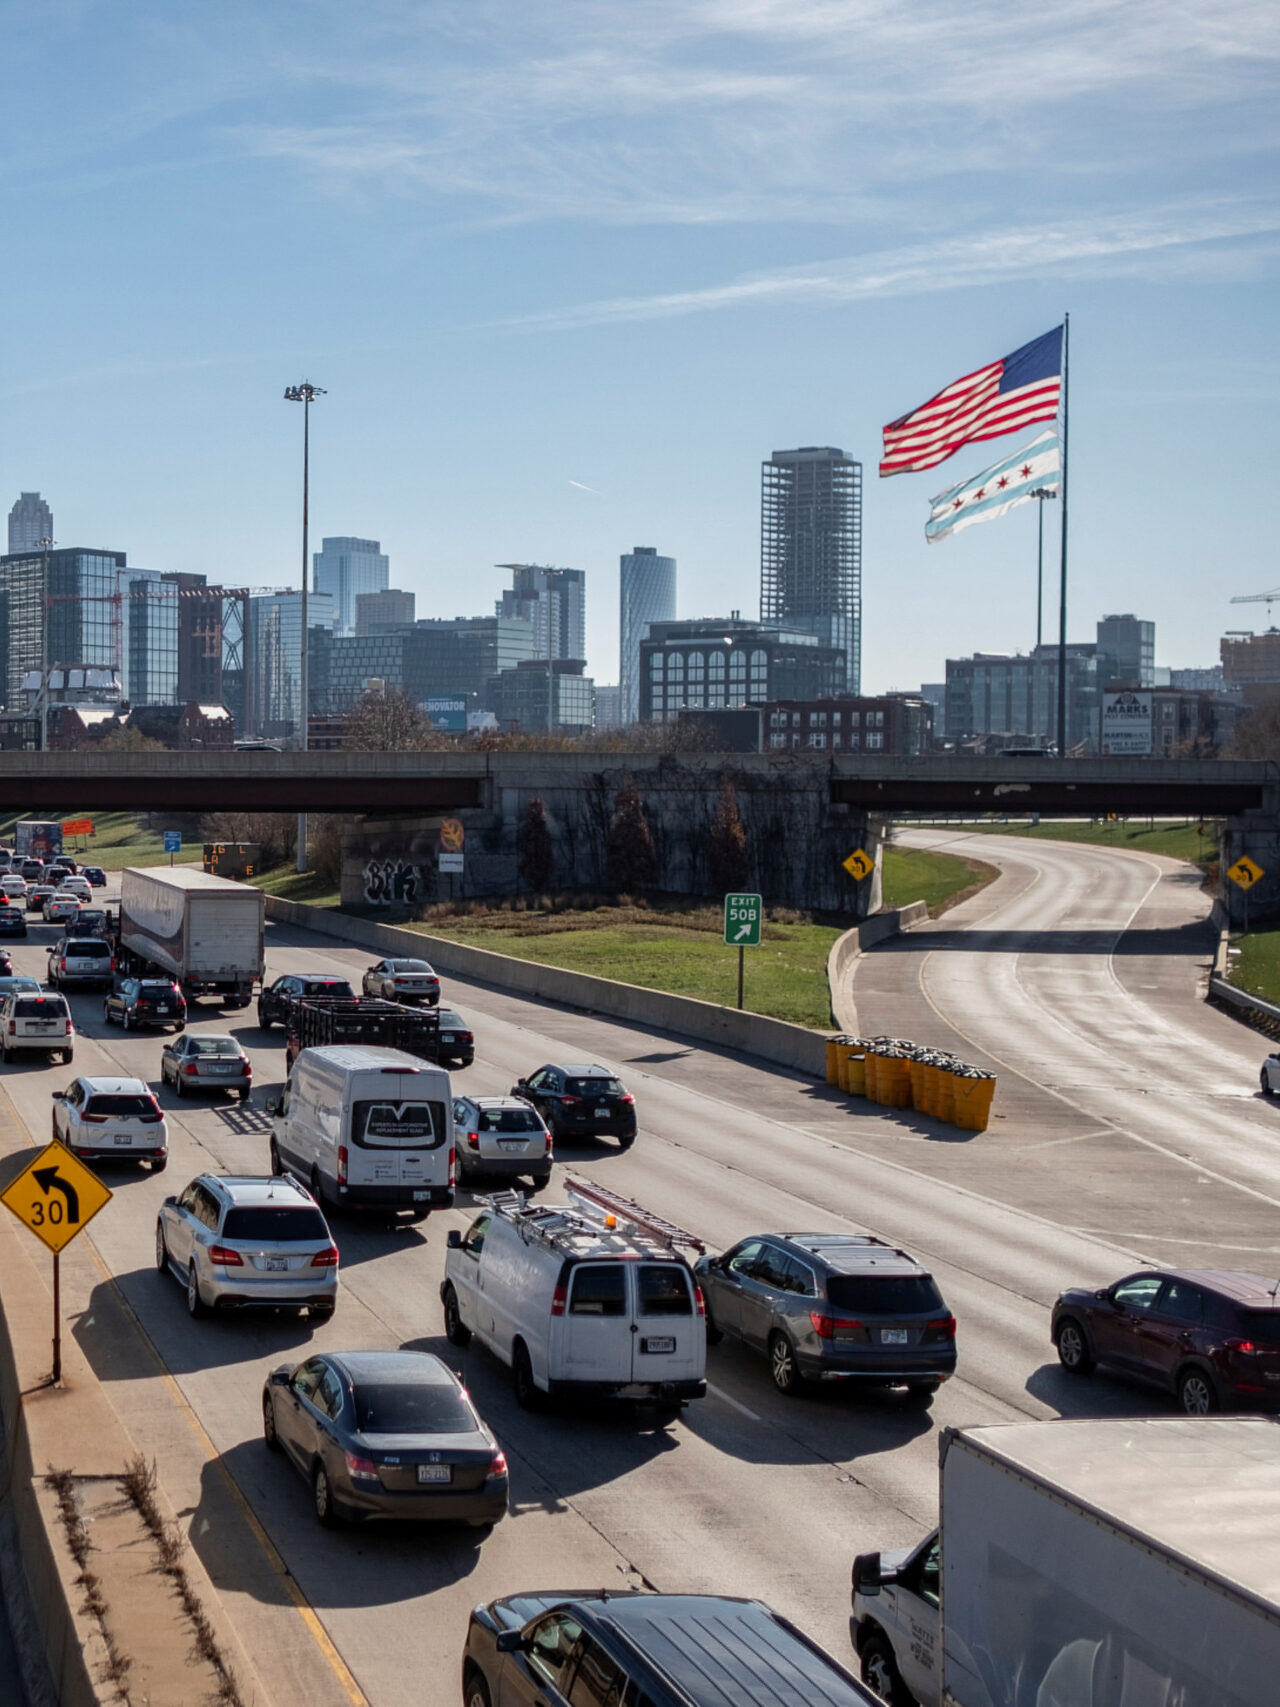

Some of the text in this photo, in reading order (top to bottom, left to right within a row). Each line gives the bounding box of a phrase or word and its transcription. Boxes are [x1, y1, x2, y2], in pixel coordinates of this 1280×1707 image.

[1107, 704, 1149, 713] MARKS
[731, 897, 756, 906] EXIT
[730, 908, 757, 921] 50B
[31, 1200, 63, 1226] 30
